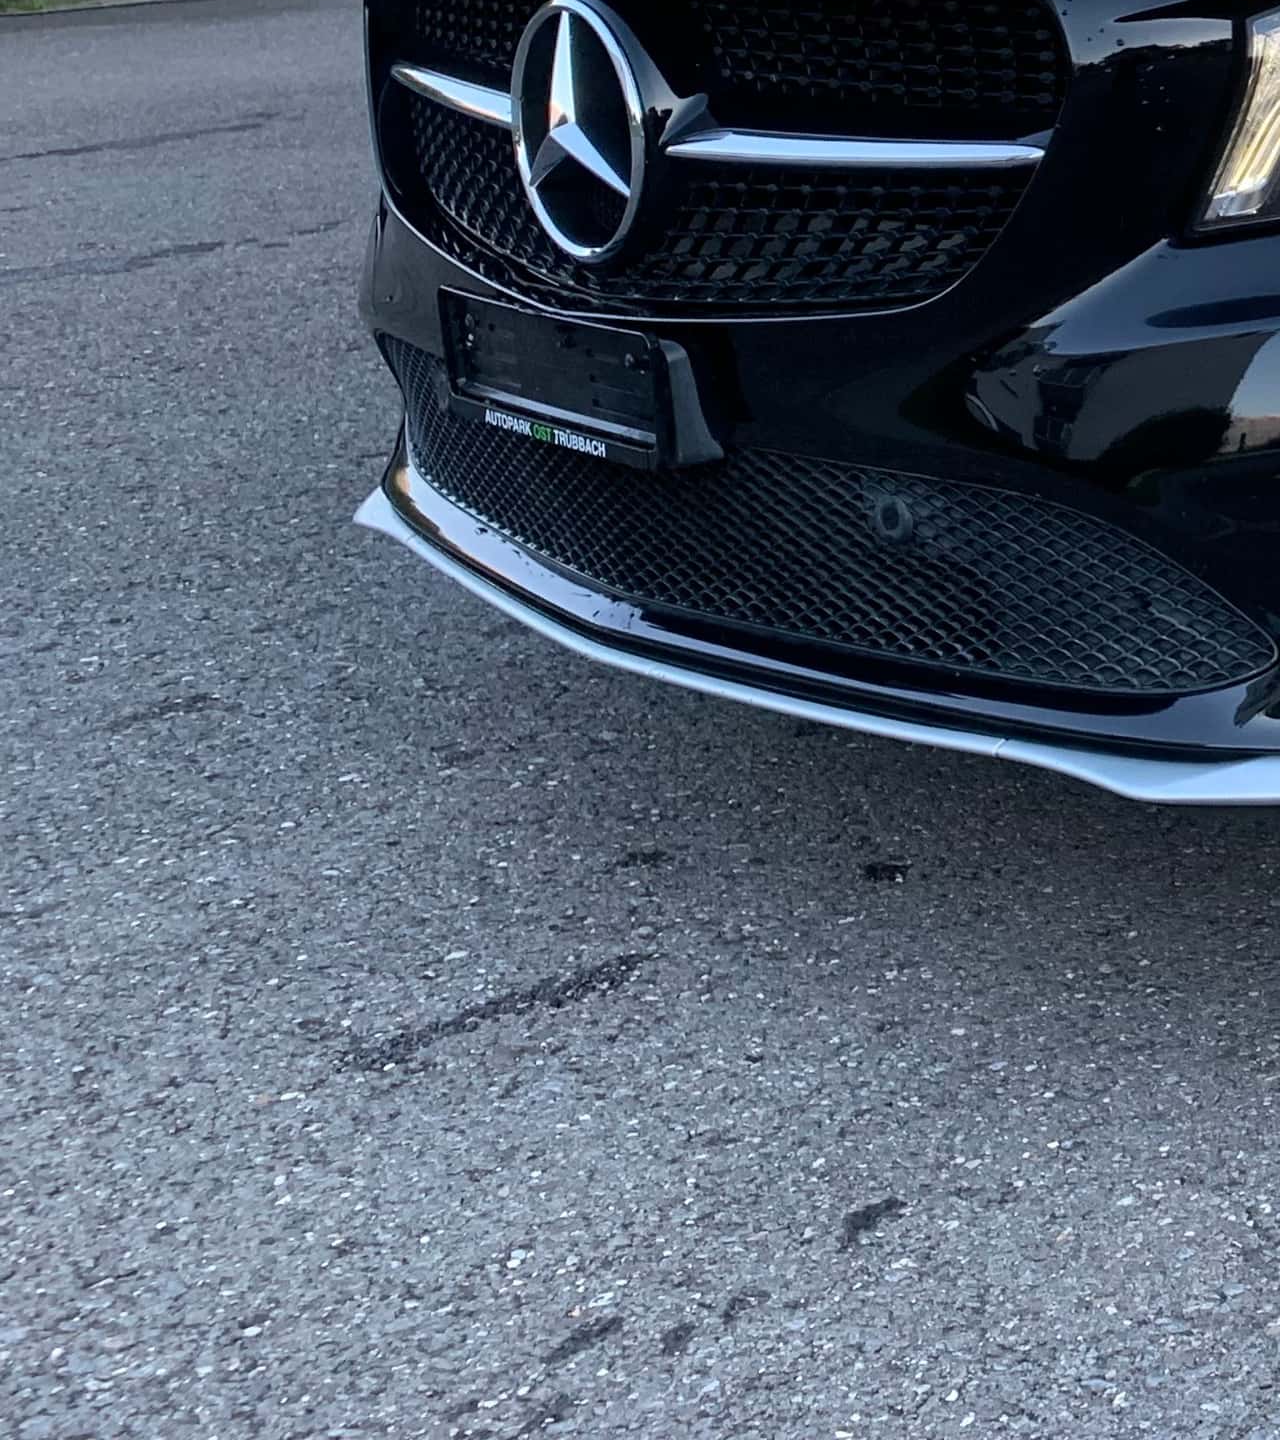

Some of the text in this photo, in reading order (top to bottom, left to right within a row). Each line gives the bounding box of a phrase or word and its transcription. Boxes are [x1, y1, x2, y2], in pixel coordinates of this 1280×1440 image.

[485, 408, 607, 459] AUTOPARK OST TRÜBBACH
